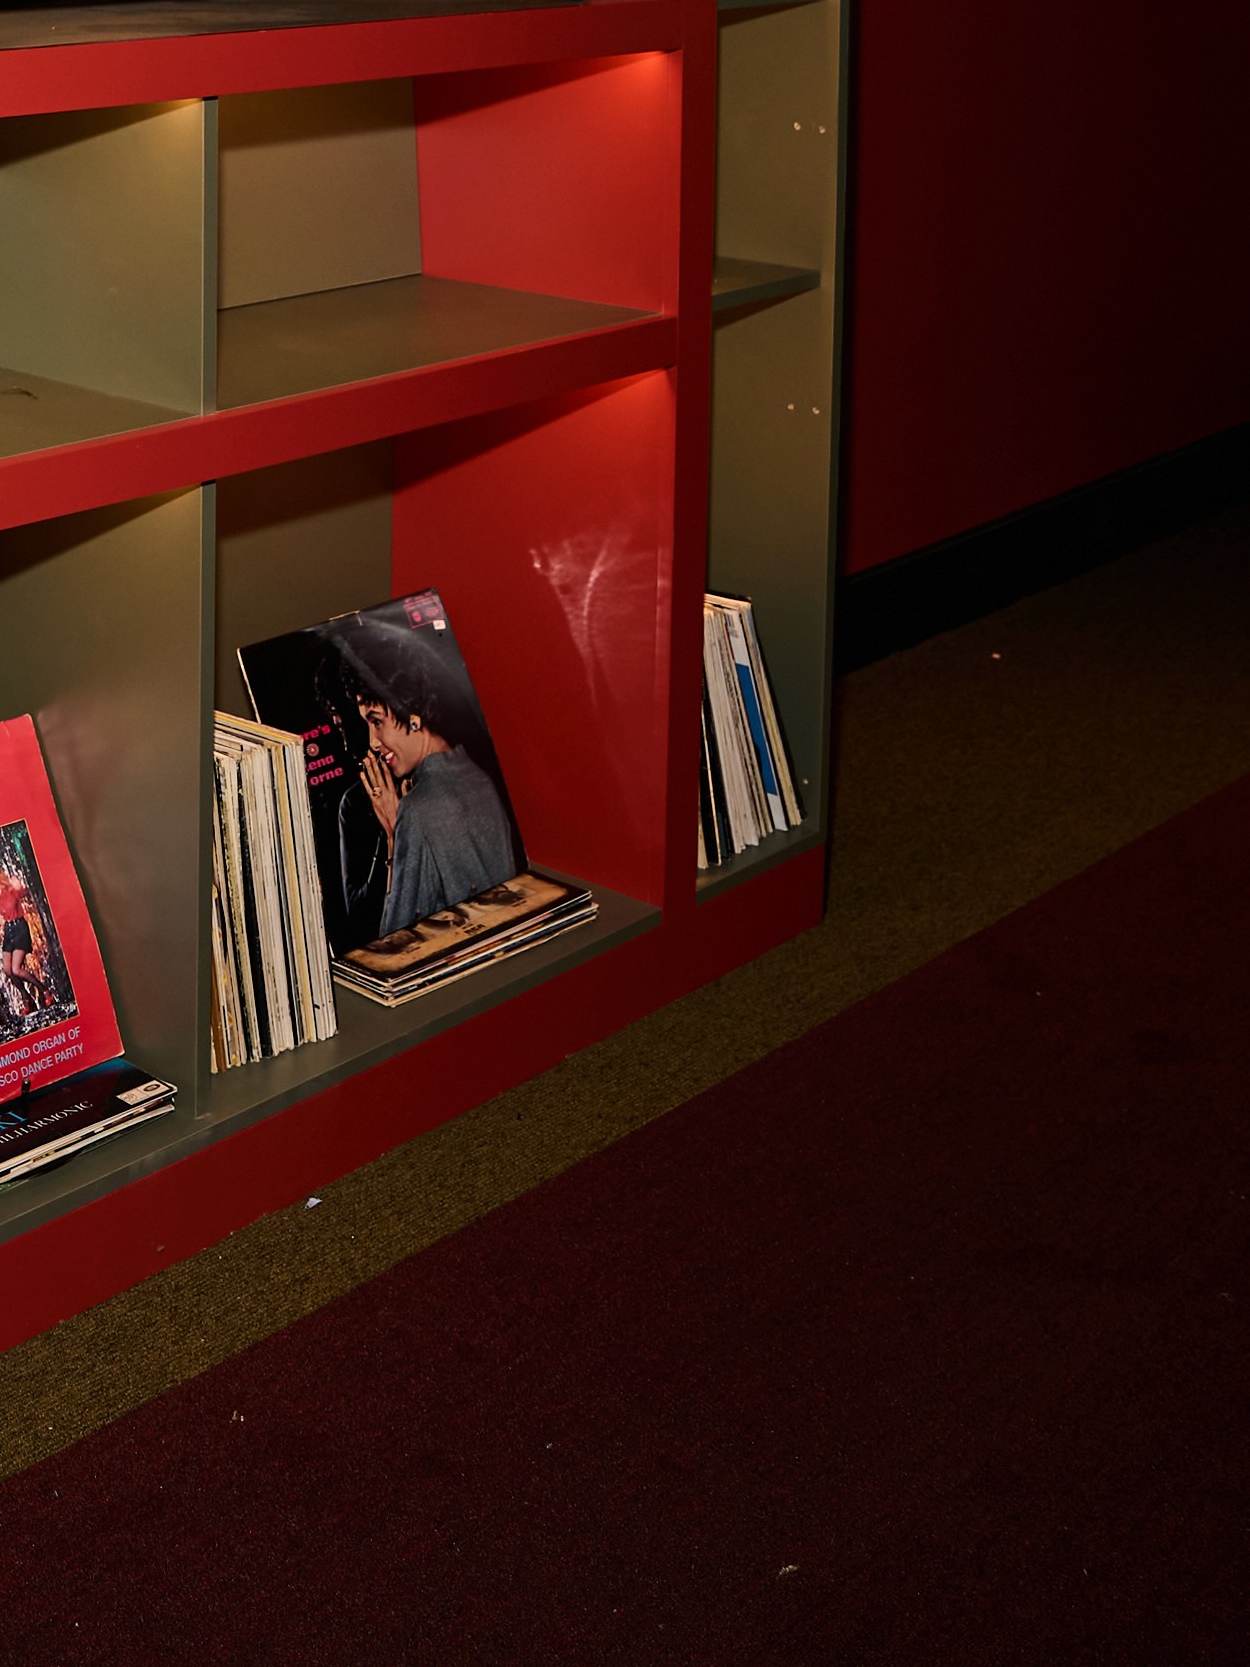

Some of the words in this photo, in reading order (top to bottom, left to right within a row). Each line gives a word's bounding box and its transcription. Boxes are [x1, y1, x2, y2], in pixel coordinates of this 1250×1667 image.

[301, 724, 330, 740] re's
[308, 755, 334, 771] ena
[310, 767, 343, 785] orne
[32, 1033, 66, 1054] ORGAN
[68, 1026, 81, 1040] OF
[20, 1057, 53, 1078] DANCE
[55, 1043, 84, 1064] PARTY
